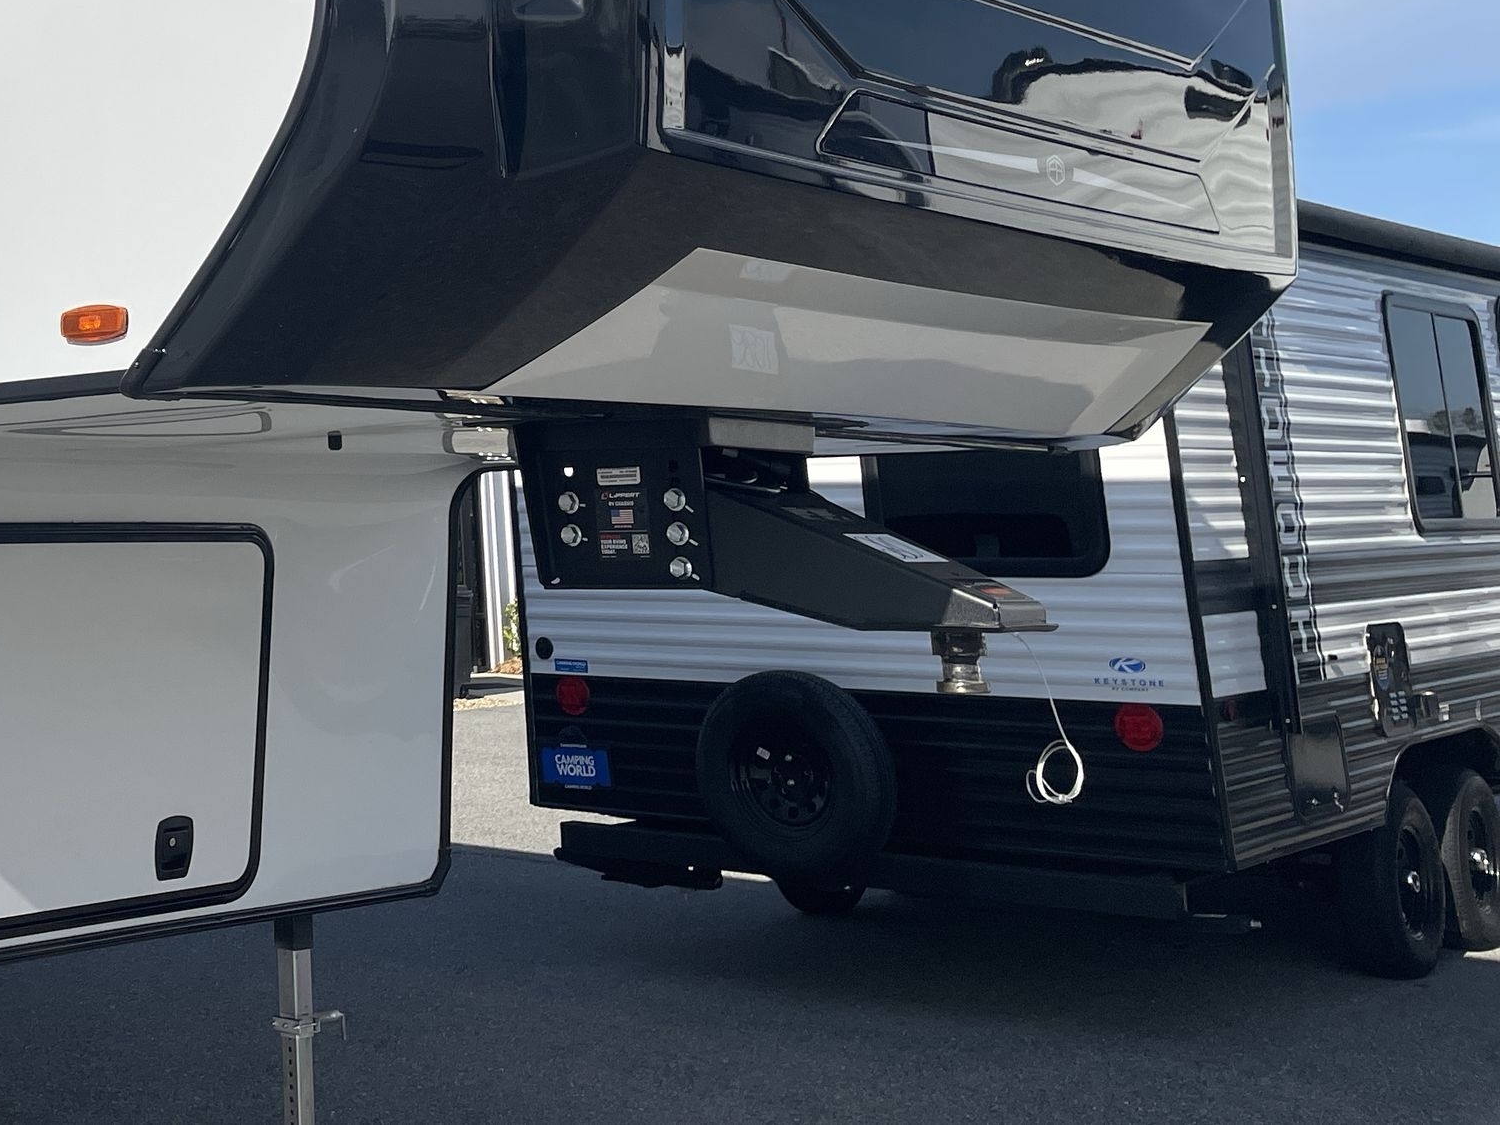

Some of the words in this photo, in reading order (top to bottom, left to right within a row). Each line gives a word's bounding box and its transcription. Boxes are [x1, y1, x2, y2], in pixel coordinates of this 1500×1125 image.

[1094, 677, 1165, 688] KEYSTONE
[554, 754, 595, 766] CAMPING
[556, 764, 596, 777] WORLD
